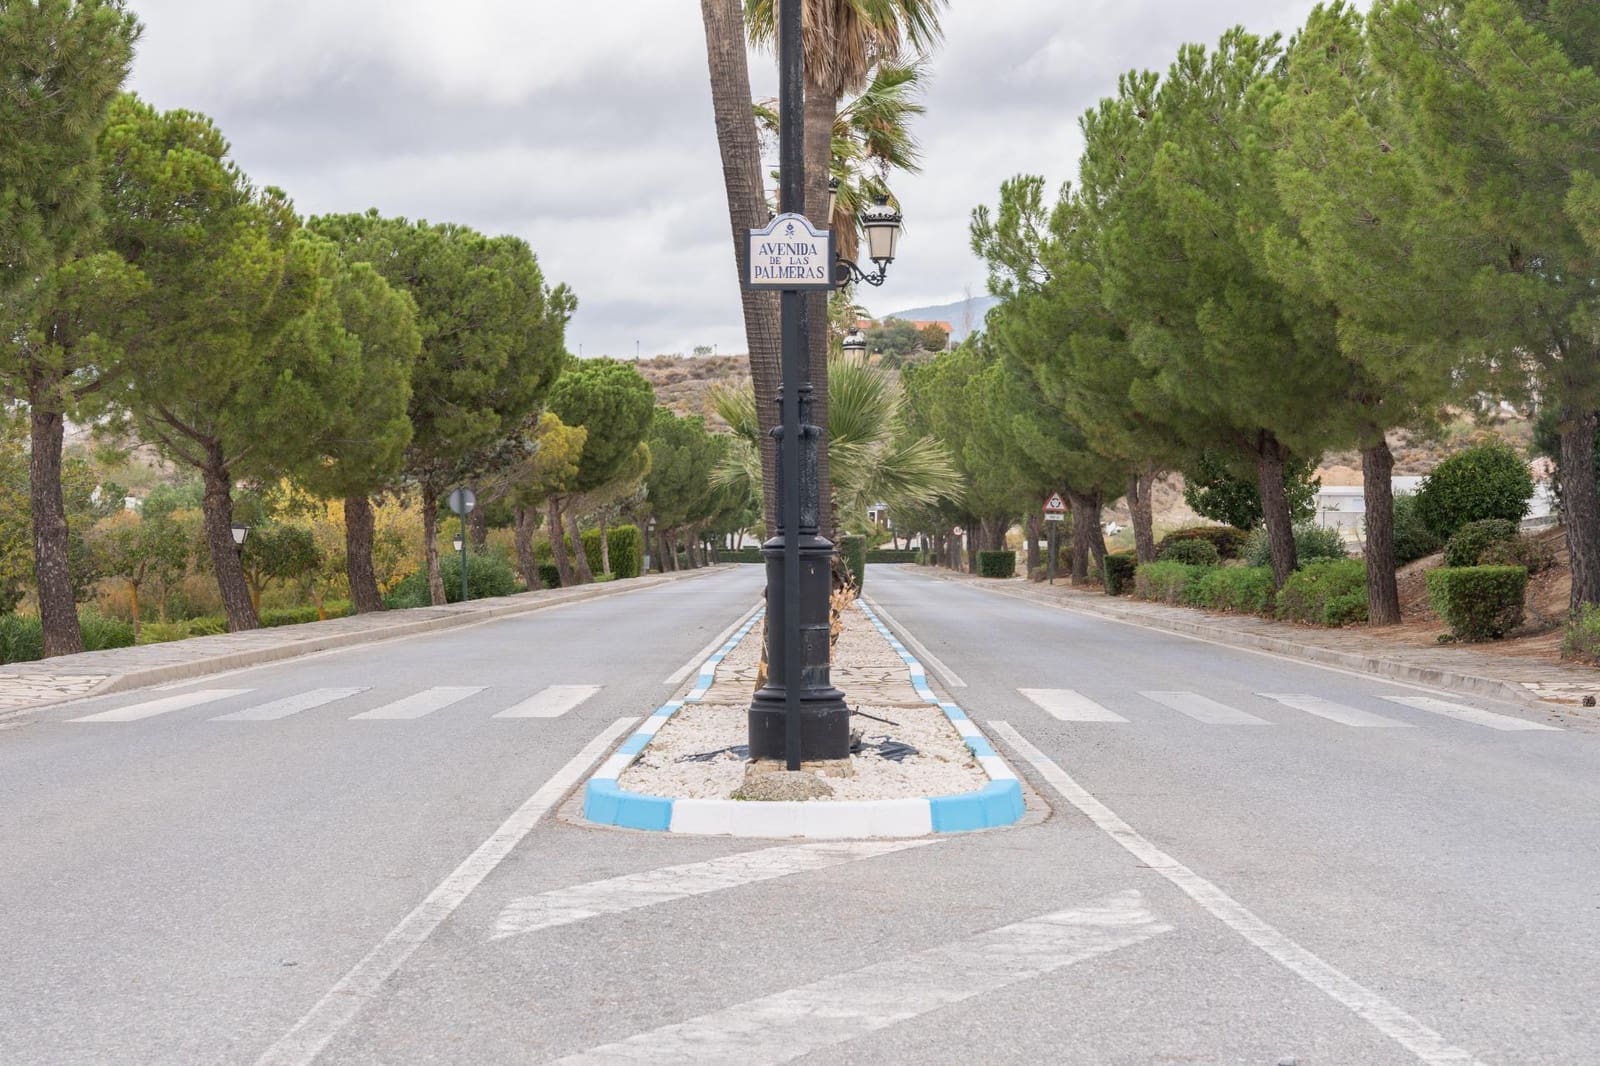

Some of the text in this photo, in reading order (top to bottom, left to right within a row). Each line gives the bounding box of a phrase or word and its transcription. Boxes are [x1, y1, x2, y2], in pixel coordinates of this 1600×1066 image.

[758, 242, 818, 256] AVENIDA
[769, 256, 809, 265] DE LAS
[754, 265, 825, 279] PALMERAS
